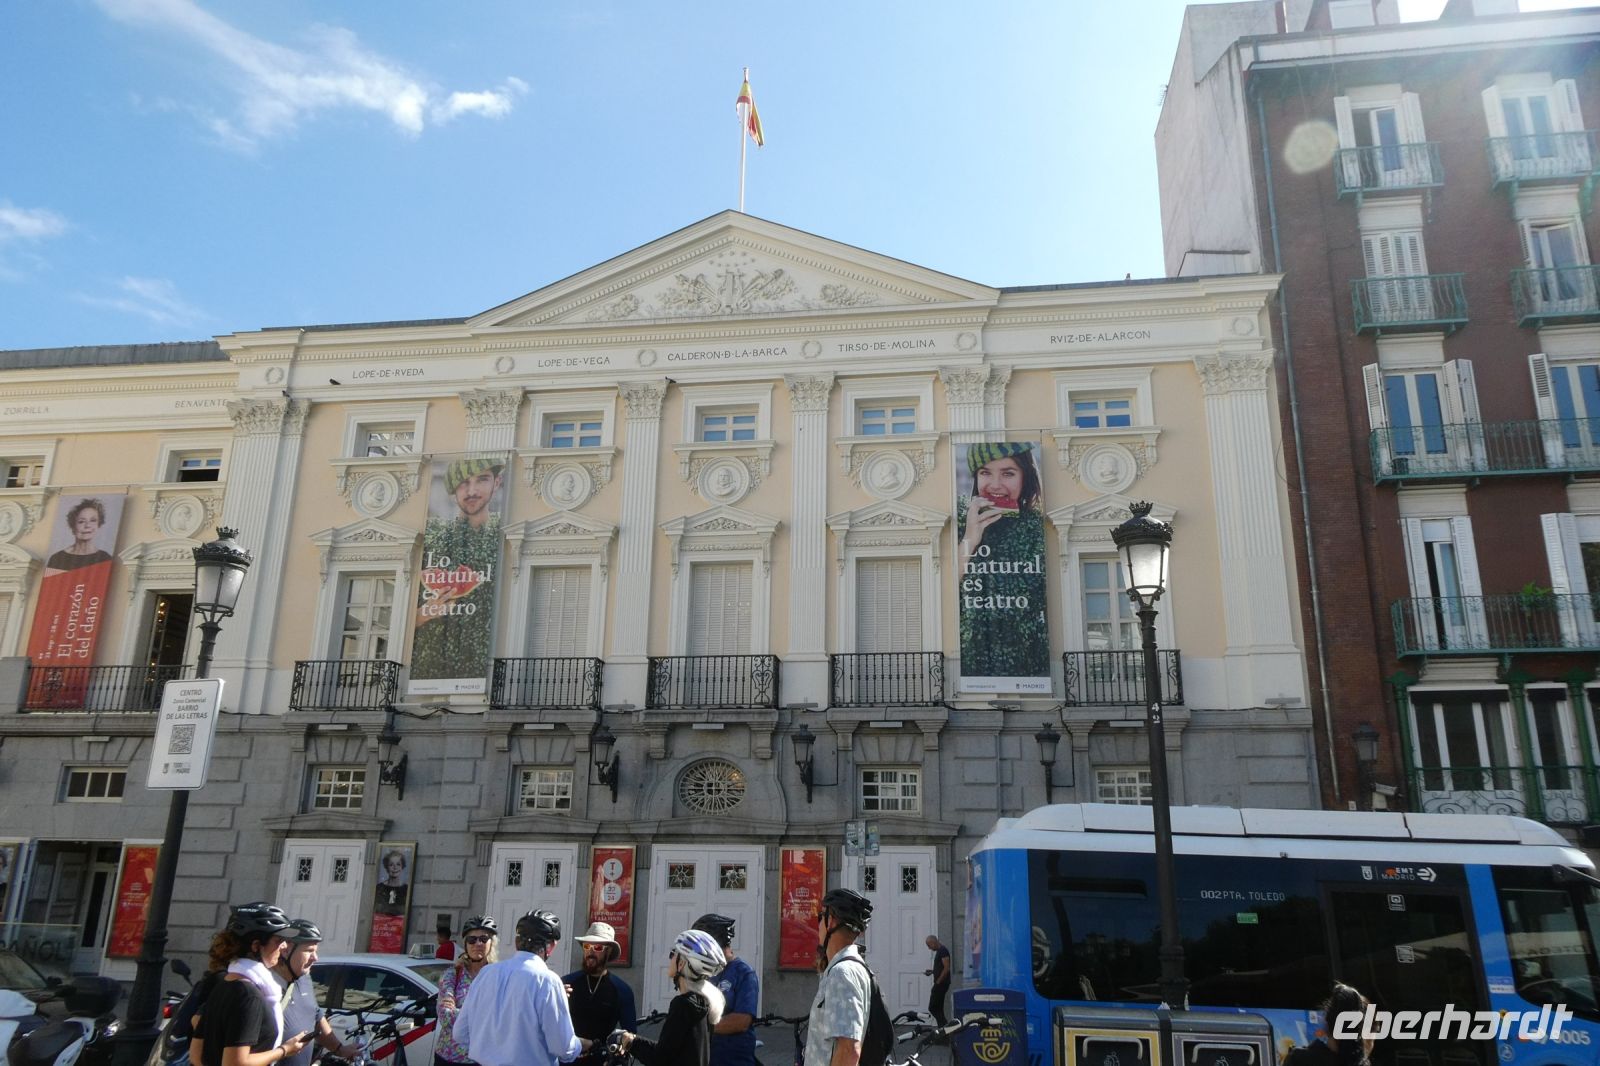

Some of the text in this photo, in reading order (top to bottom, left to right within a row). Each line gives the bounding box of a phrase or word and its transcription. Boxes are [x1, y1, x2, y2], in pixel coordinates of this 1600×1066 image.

[962, 540, 991, 558] Lo
[426, 551, 451, 569] Lo
[963, 555, 1042, 575] natural
[424, 563, 493, 585] natural
[962, 576, 984, 593] es
[422, 587, 440, 601] es
[963, 595, 1029, 610] teatro
[421, 601, 476, 618] teatro
[57, 583, 85, 658] El corazón
[74, 596, 100, 658] del daño
[180, 689, 203, 697] CENTRO
[165, 712, 209, 721] DE LAS LETRAS
[177, 704, 199, 712] BARRIO
[1248, 891, 1286, 901] TOLEDO
